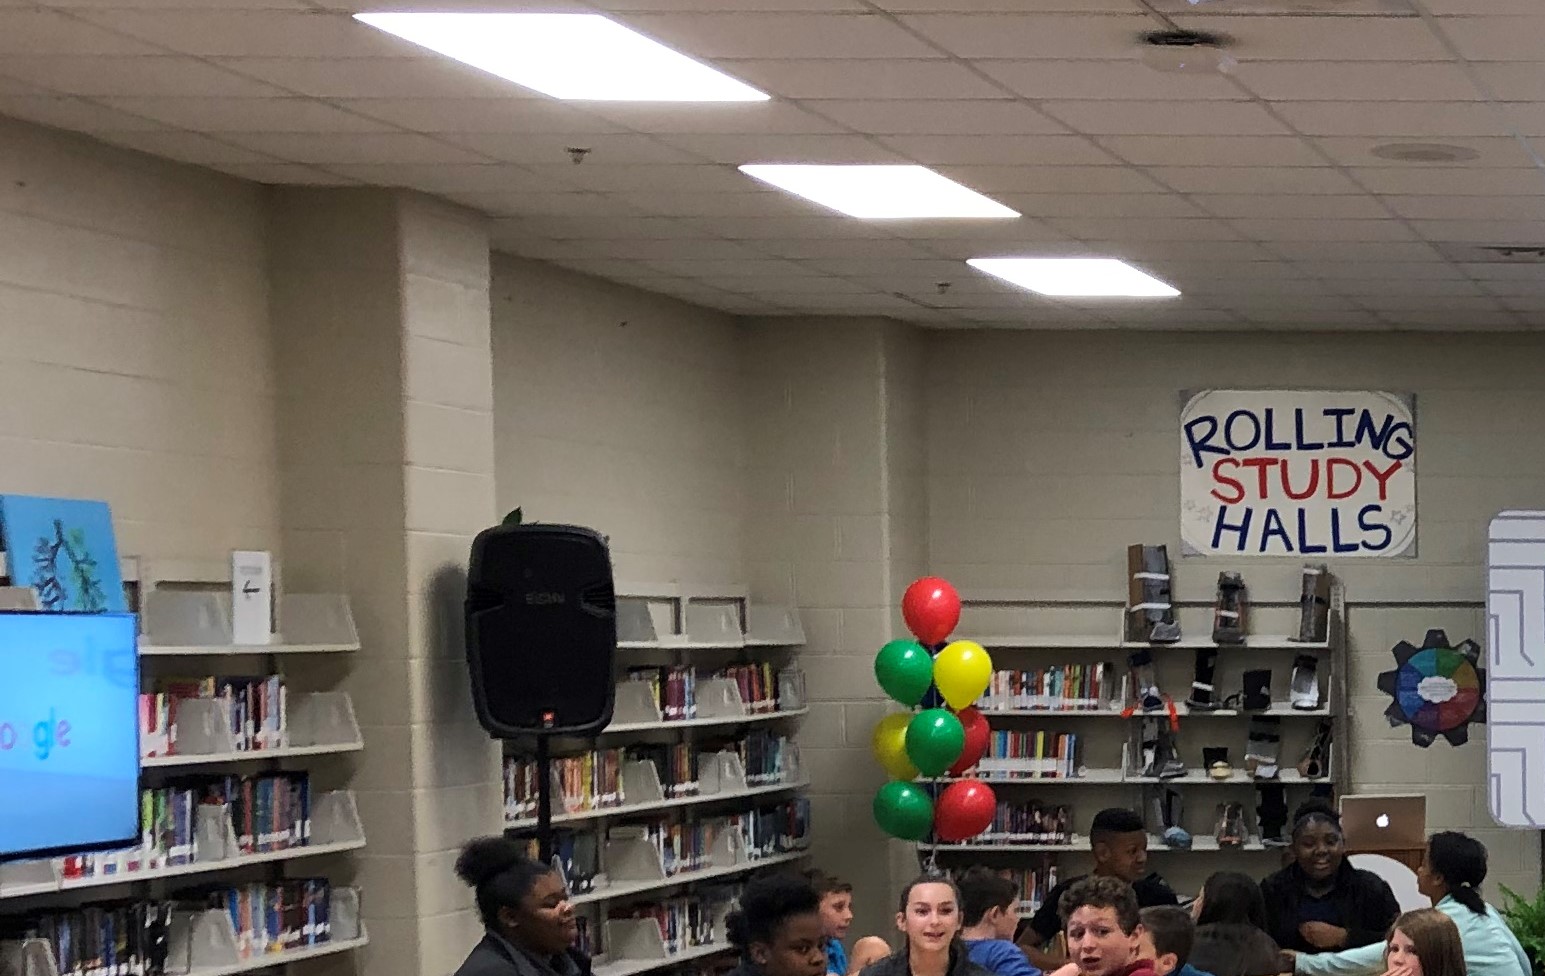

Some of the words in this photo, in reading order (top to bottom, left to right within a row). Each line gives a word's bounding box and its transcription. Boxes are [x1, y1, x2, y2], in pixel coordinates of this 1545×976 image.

[1184, 408, 1413, 468] ROLLING
[1210, 457, 1402, 504] STUDY
[1211, 505, 1392, 554] HALLS
[0, 706, 72, 760] ogle
